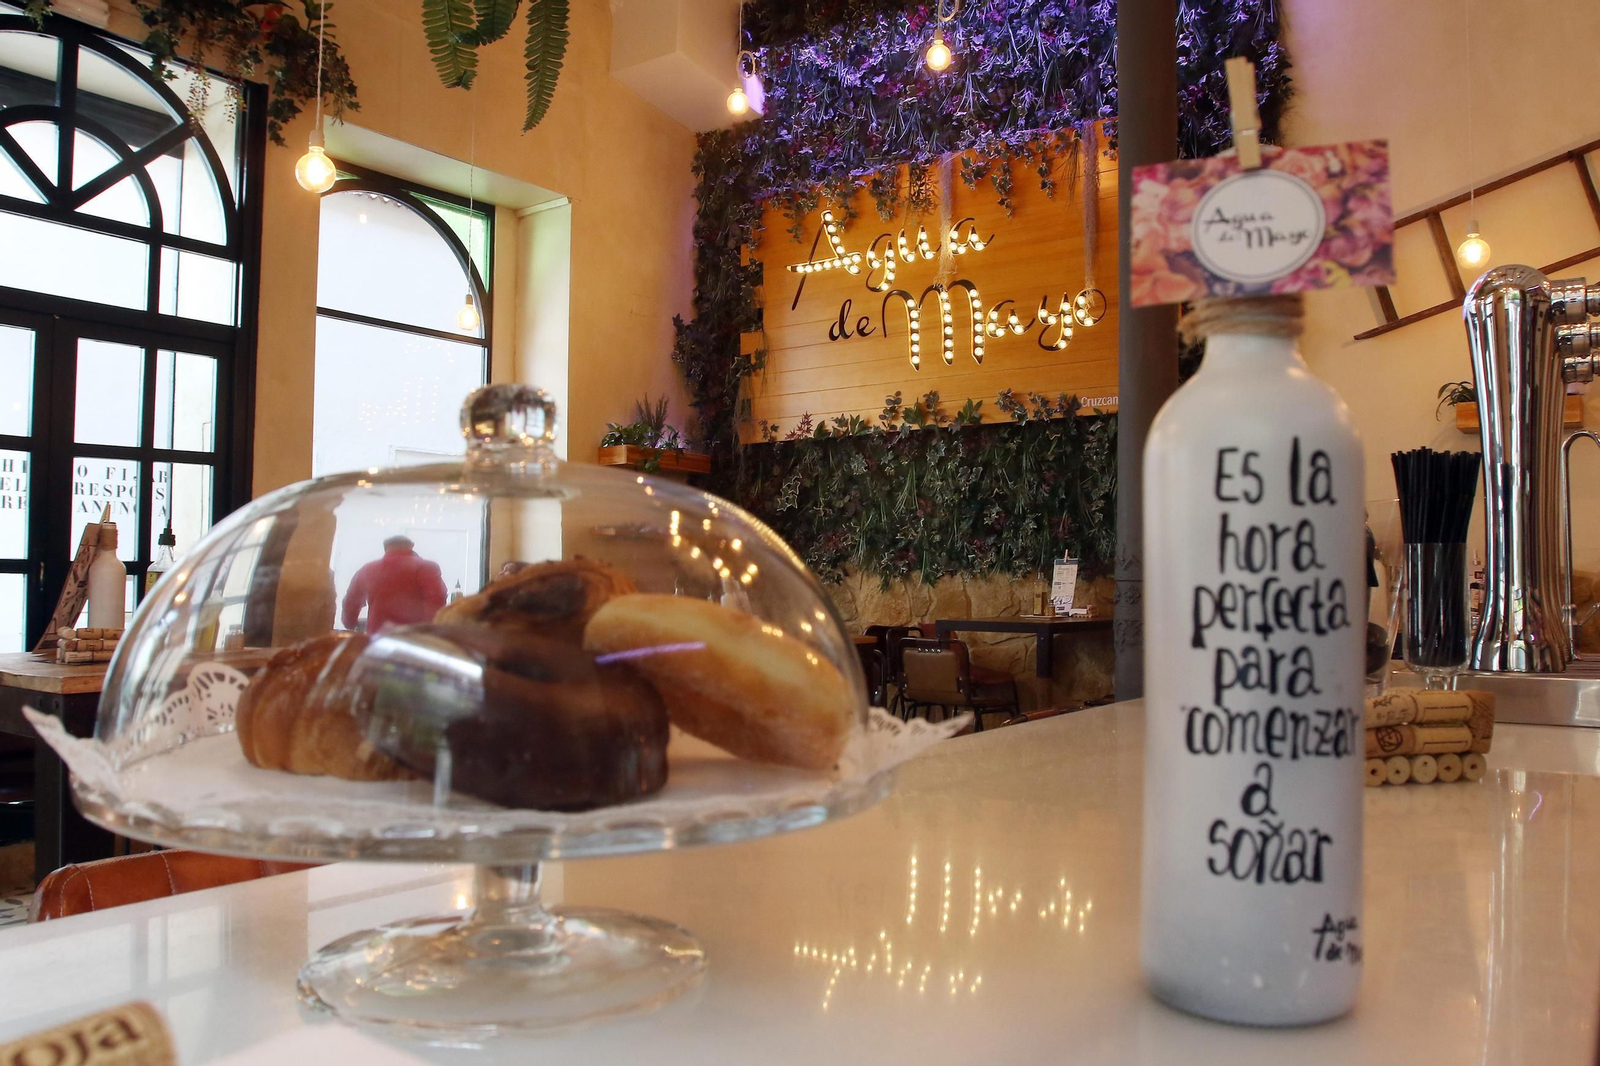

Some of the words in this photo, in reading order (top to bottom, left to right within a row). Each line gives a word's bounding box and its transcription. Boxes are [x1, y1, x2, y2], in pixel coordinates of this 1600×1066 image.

[786, 208, 996, 310] Agua
[828, 298, 877, 342] de
[881, 279, 1107, 372] Mayo
[1289, 435, 1337, 507] la
[1218, 512, 1326, 574] hora
[1191, 577, 1352, 649] perfecta
[1214, 645, 1323, 706] para
[1185, 706, 1360, 760] comenzar
[1240, 762, 1277, 817] a
[1207, 818, 1333, 885] soñar
